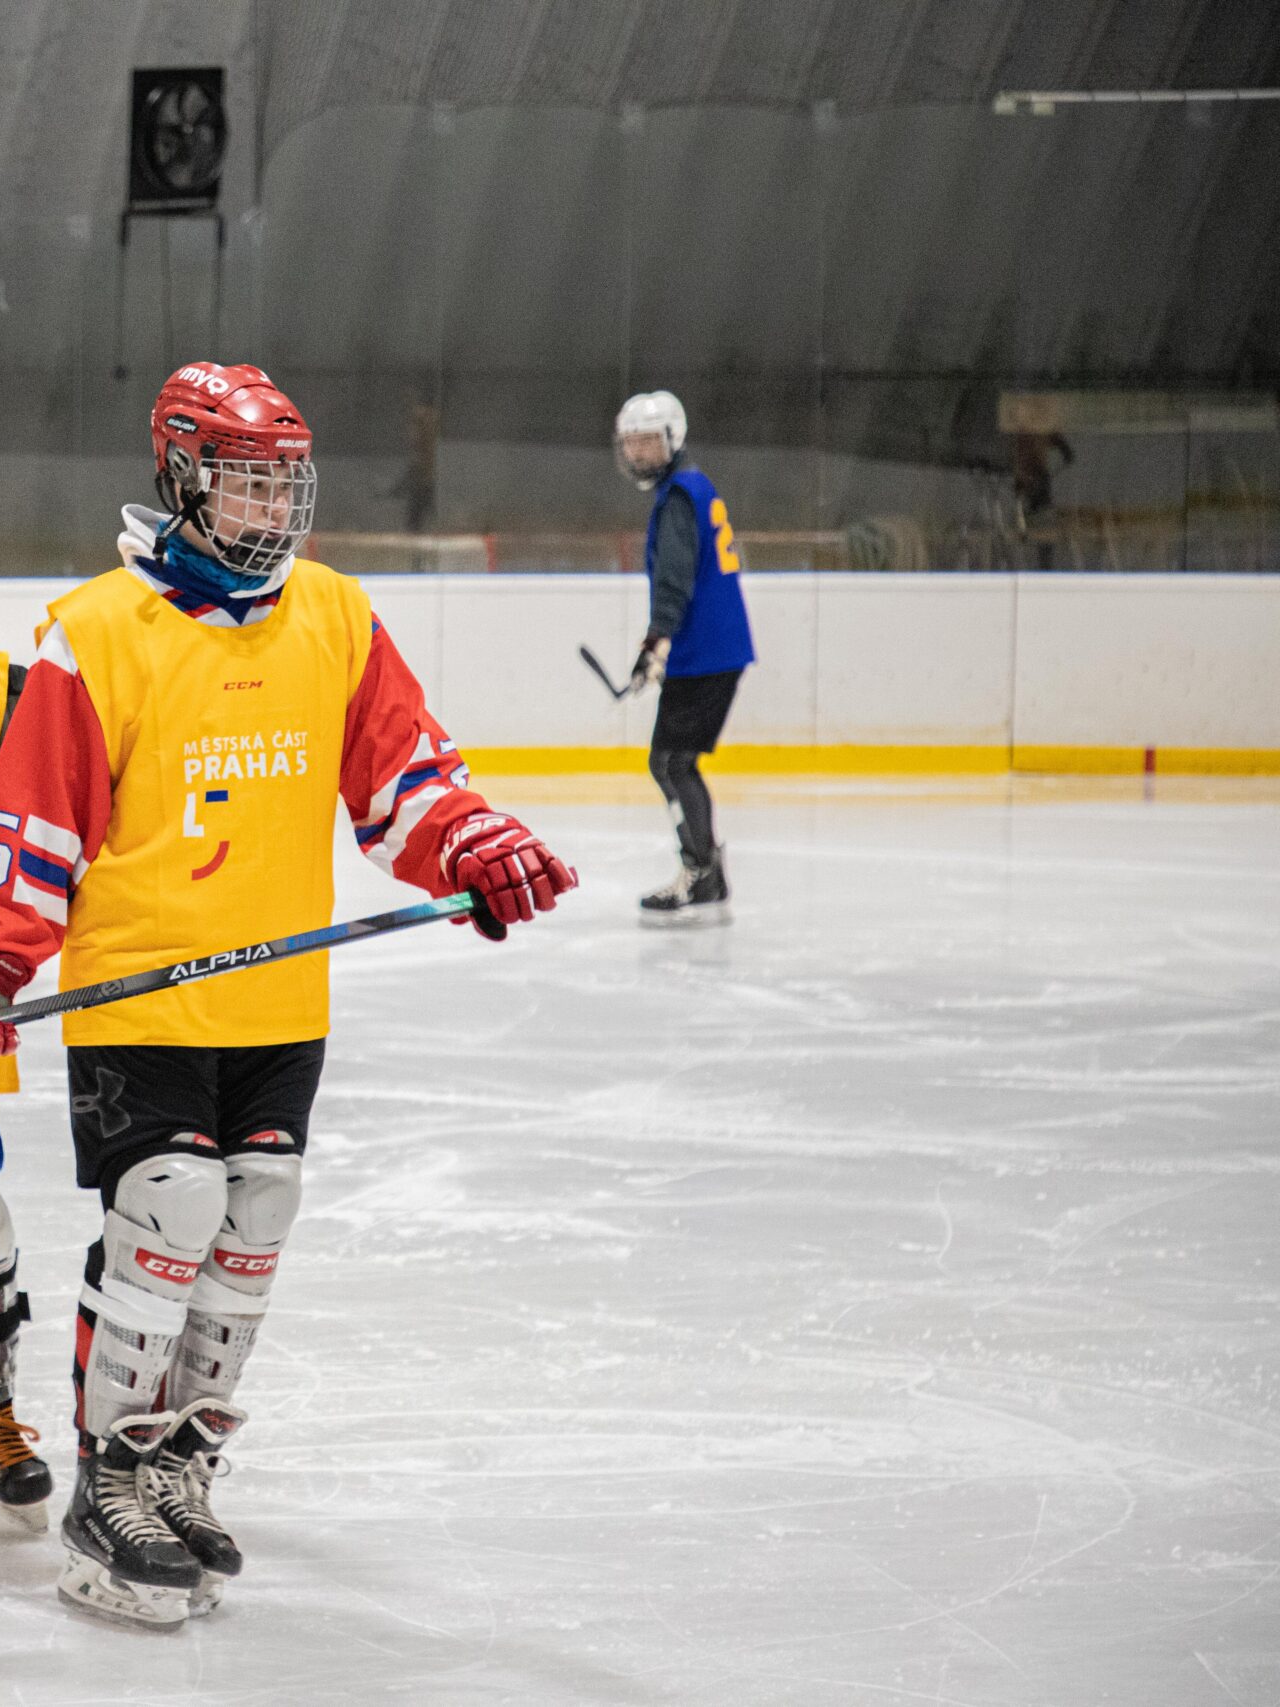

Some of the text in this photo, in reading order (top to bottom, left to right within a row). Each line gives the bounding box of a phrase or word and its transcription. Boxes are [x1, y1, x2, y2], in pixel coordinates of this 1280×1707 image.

[223, 680, 263, 691] CCM
[183, 728, 308, 757] MĚSTSKÁ ČÁST
[183, 749, 308, 784] PRAHA 5
[169, 942, 273, 981] ALPHA
[145, 1257, 199, 1279] CCM
[223, 1256, 277, 1279] CCM
